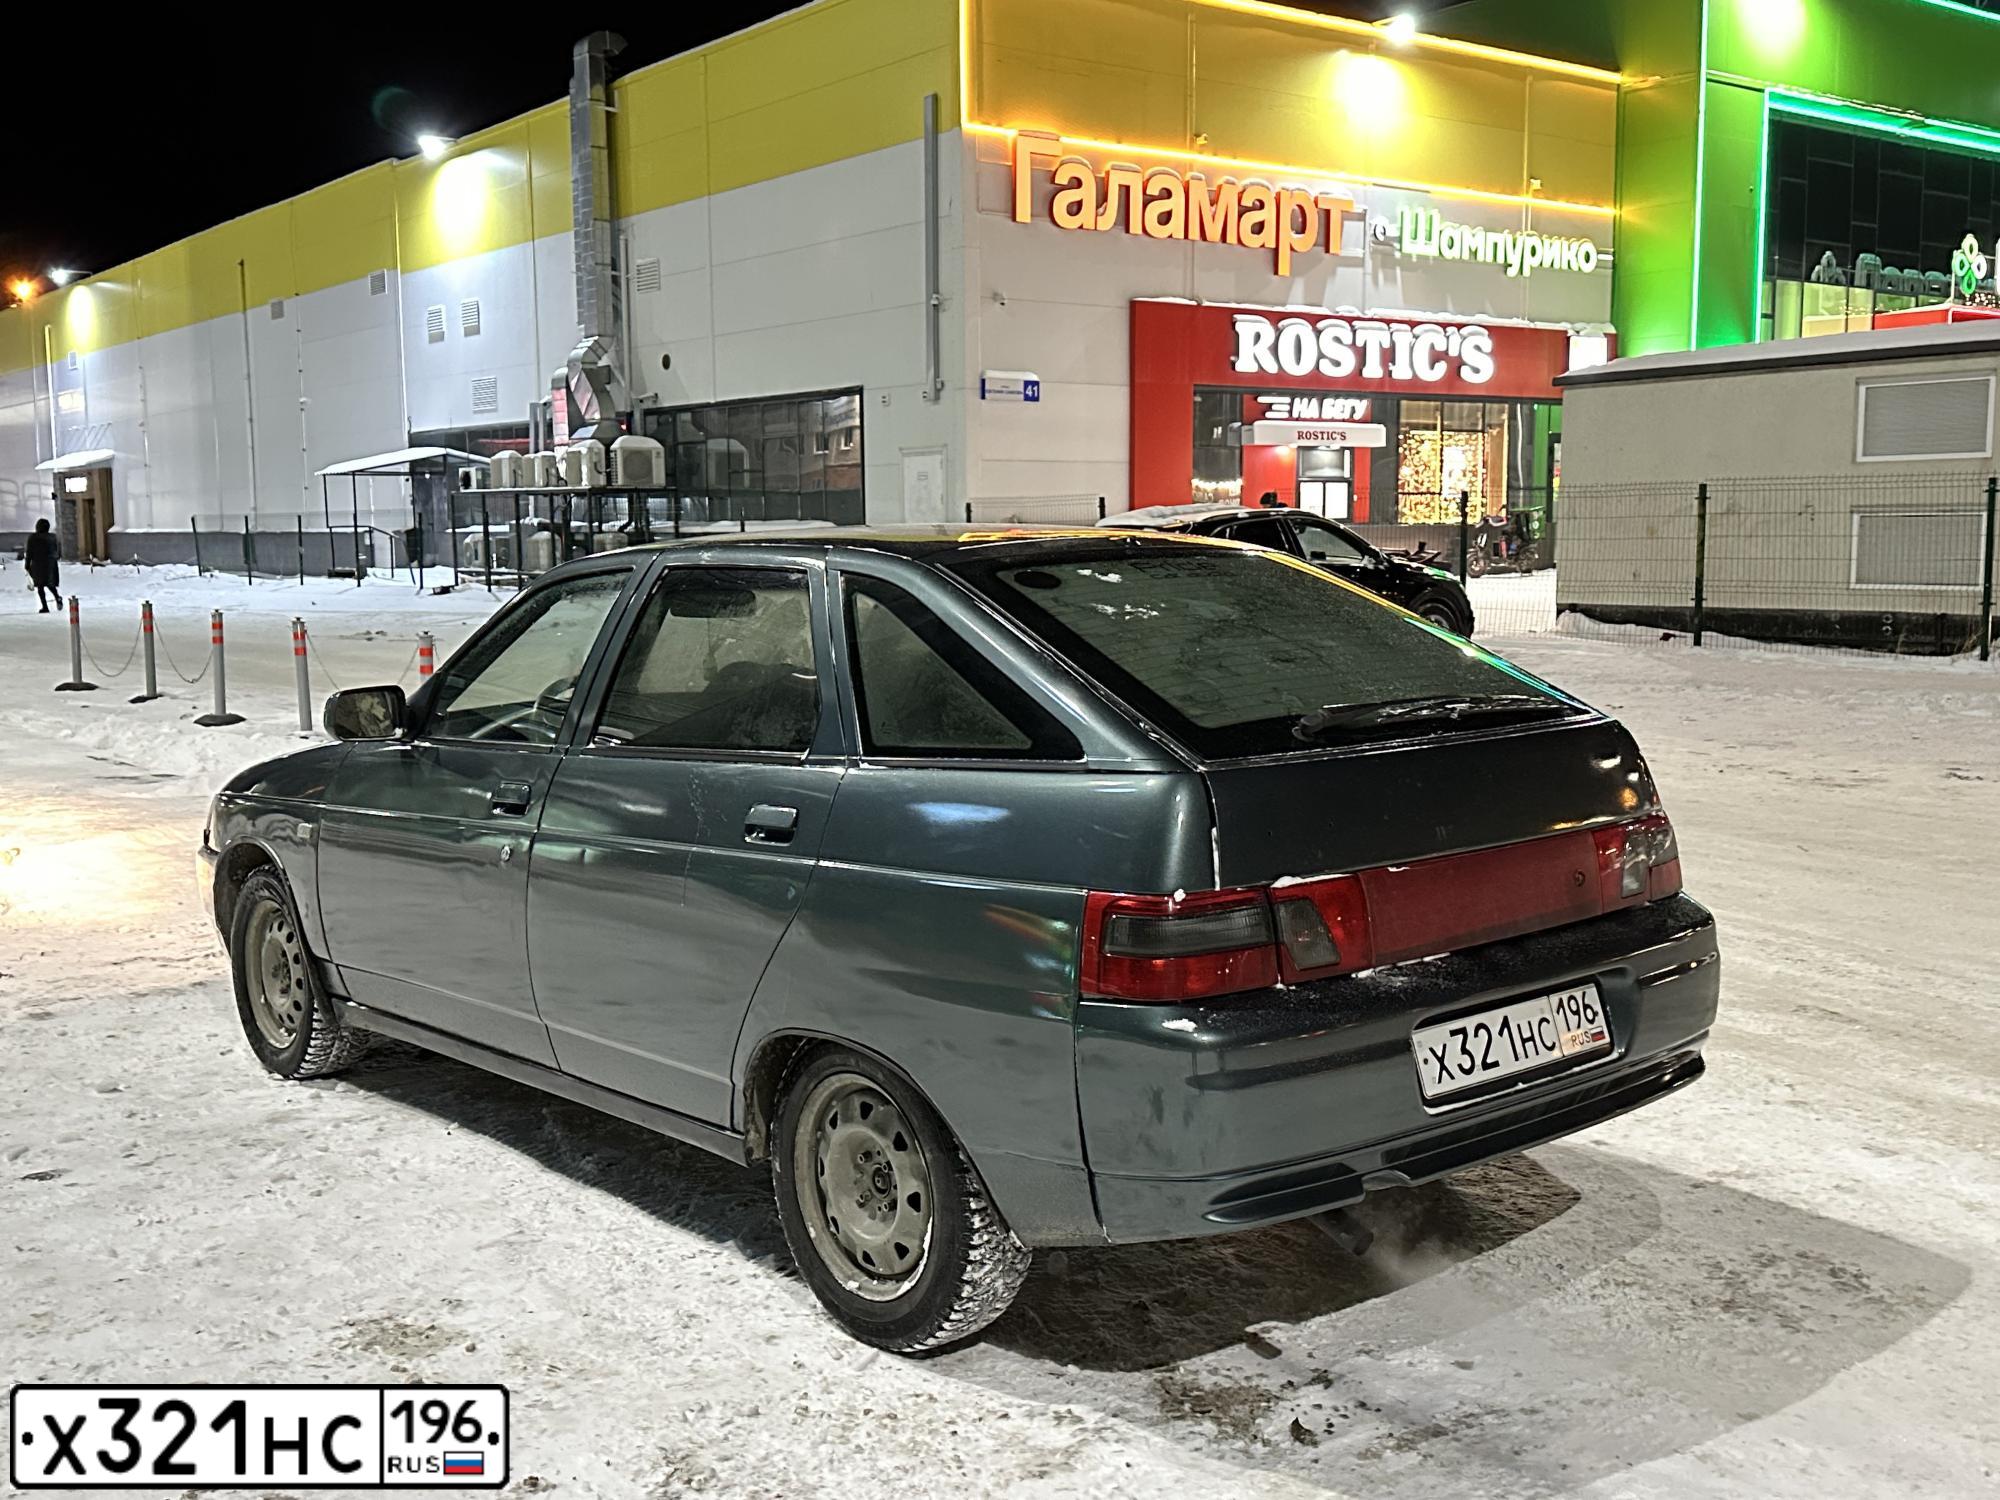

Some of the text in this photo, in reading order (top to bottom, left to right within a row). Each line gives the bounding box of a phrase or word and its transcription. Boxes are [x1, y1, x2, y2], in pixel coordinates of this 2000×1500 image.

[1012, 131, 1354, 277] Галамарт
[1400, 207, 1598, 277] Шампурико
[1233, 318, 1494, 384] ROSTIC'S
[1025, 384, 1039, 398] 41
[1292, 397, 1368, 420] НА БЕГУ
[1297, 430, 1347, 441] ROSTIC'S
[1429, 991, 1596, 1084] Х321НС 196
[1570, 1030, 1591, 1047] RUS
